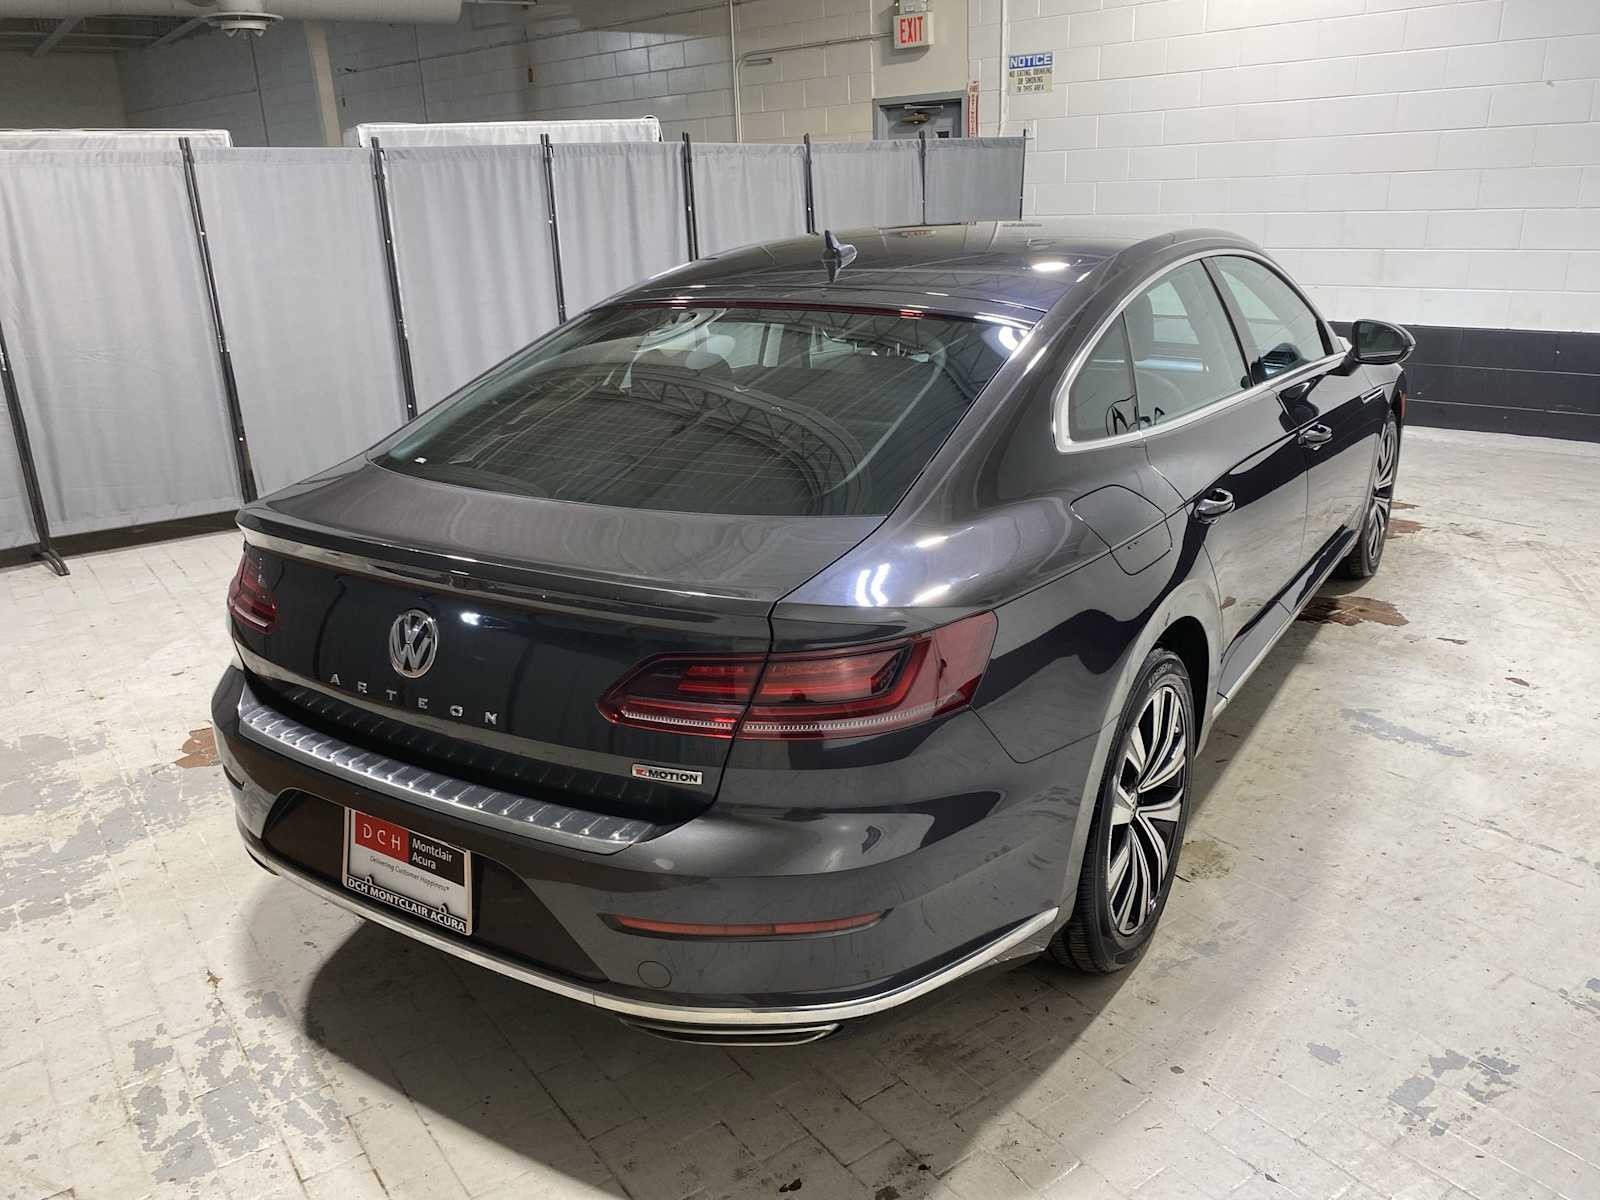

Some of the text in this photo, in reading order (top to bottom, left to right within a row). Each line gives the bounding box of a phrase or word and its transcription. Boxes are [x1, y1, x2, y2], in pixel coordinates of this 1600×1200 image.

[900, 16, 923, 43] EXIT
[1010, 54, 1052, 68] NOTICE
[329, 673, 498, 725] ARTEON
[363, 823, 401, 851] DCH
[412, 838, 453, 863] Montclair
[412, 852, 437, 870] Acura
[347, 878, 466, 933] DCH MONTCLAIR ACURA
